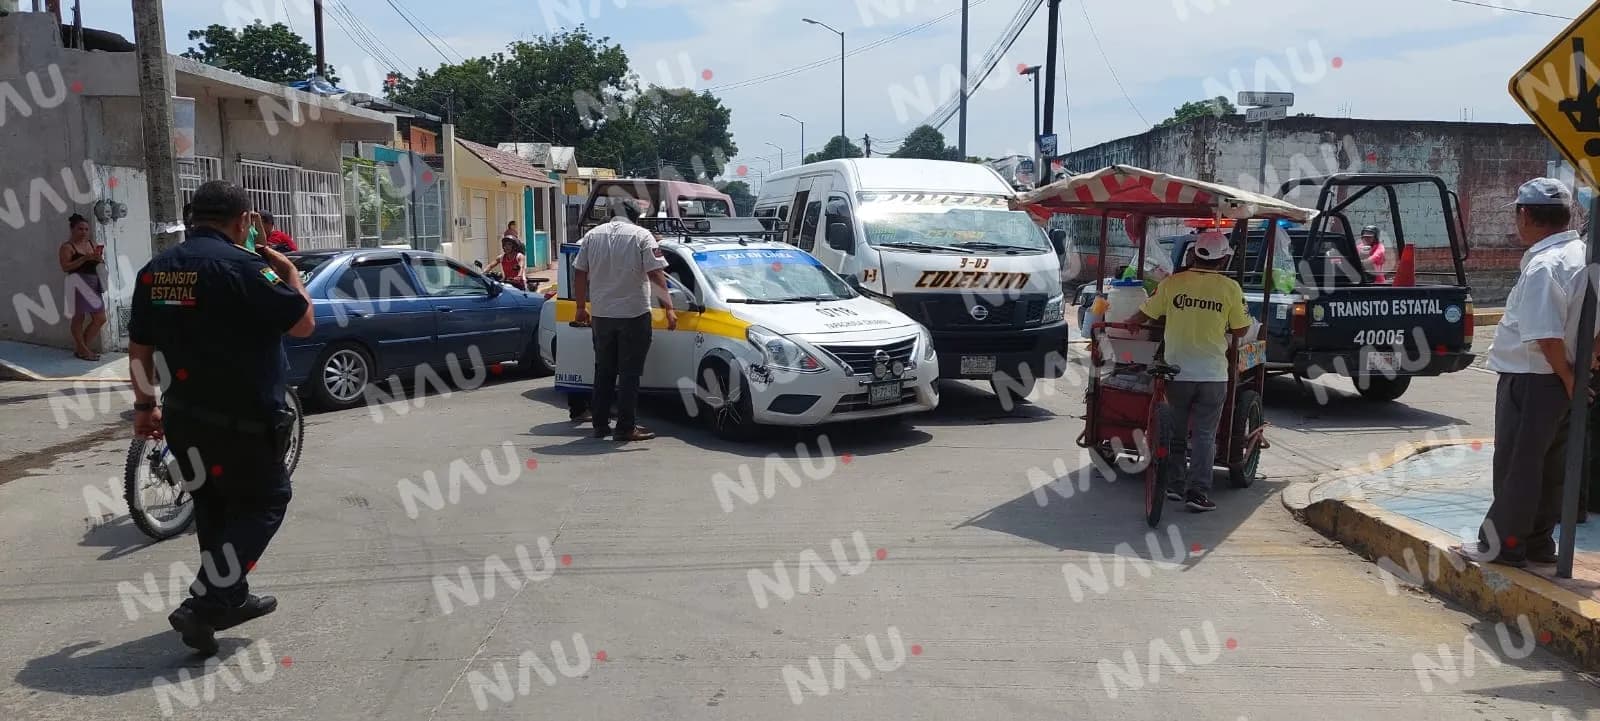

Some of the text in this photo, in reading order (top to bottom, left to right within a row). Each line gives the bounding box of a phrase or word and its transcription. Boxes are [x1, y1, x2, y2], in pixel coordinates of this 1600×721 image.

[960, 258, 989, 268] 9-03
[153, 272, 198, 285] TRANSITO
[915, 271, 1031, 289] COLECTIVO
[151, 287, 196, 300] ESTATAL
[1172, 294, 1223, 312] Corona
[1329, 300, 1389, 318] TRANSITO
[1392, 299, 1443, 315] ESTATAL
[1353, 329, 1405, 346] 40005
